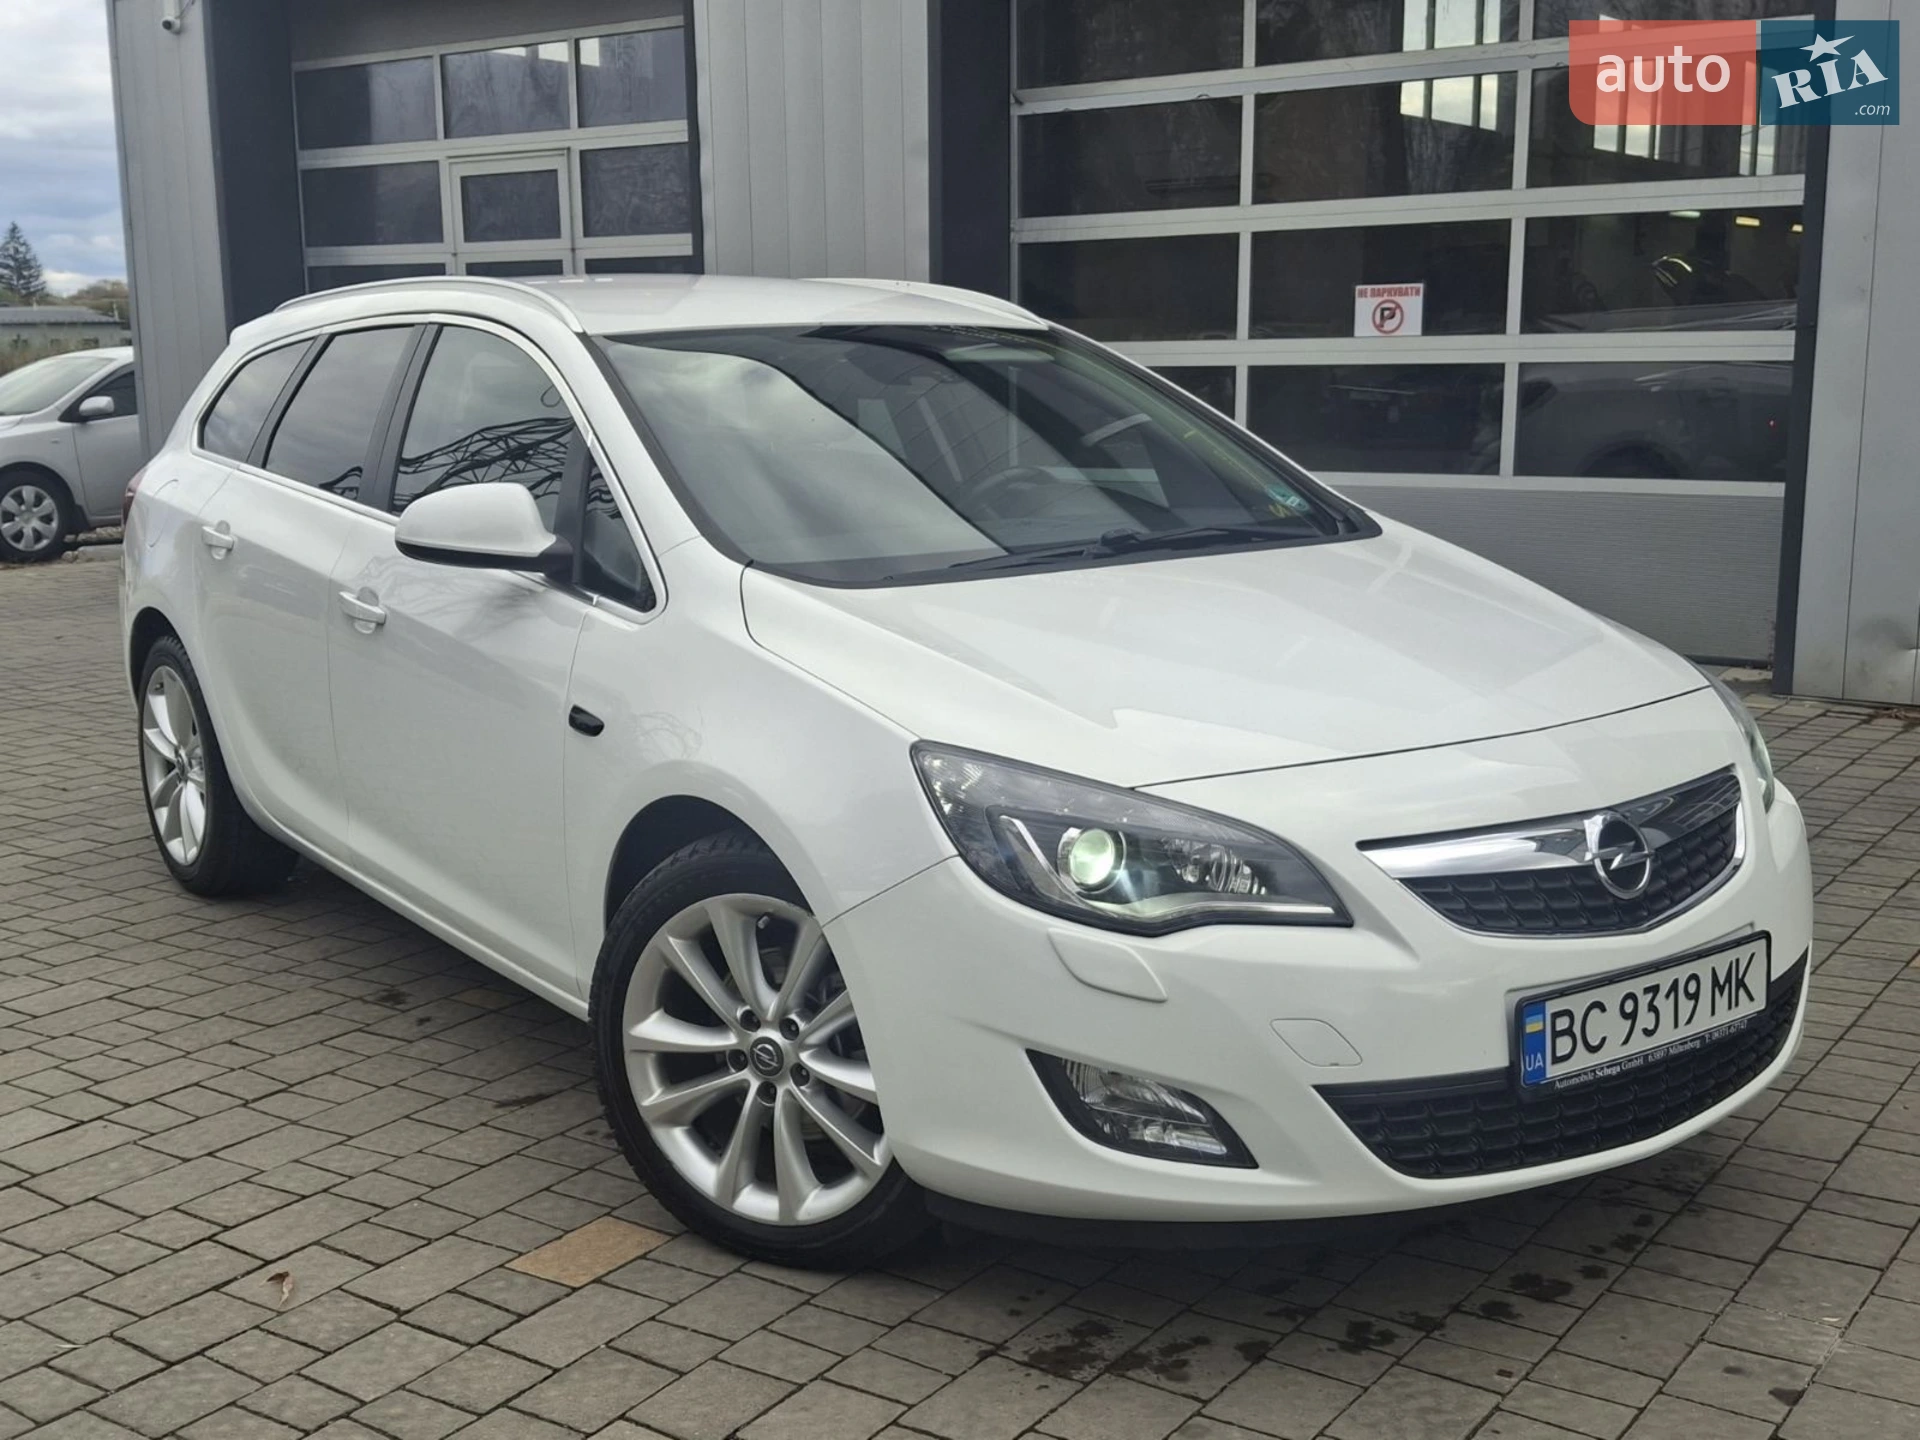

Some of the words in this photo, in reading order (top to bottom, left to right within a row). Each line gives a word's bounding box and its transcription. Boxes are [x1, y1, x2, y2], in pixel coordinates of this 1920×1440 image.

[1357, 287, 1369, 298] НЕ
[1370, 286, 1421, 298] ПАРКУВАТИ
[1550, 1000, 1607, 1066] BC
[1618, 972, 1701, 1047] 9319
[1711, 952, 1756, 1017] MK
[1525, 1052, 1544, 1072] UA
[1621, 1057, 1644, 1071] GmbH
